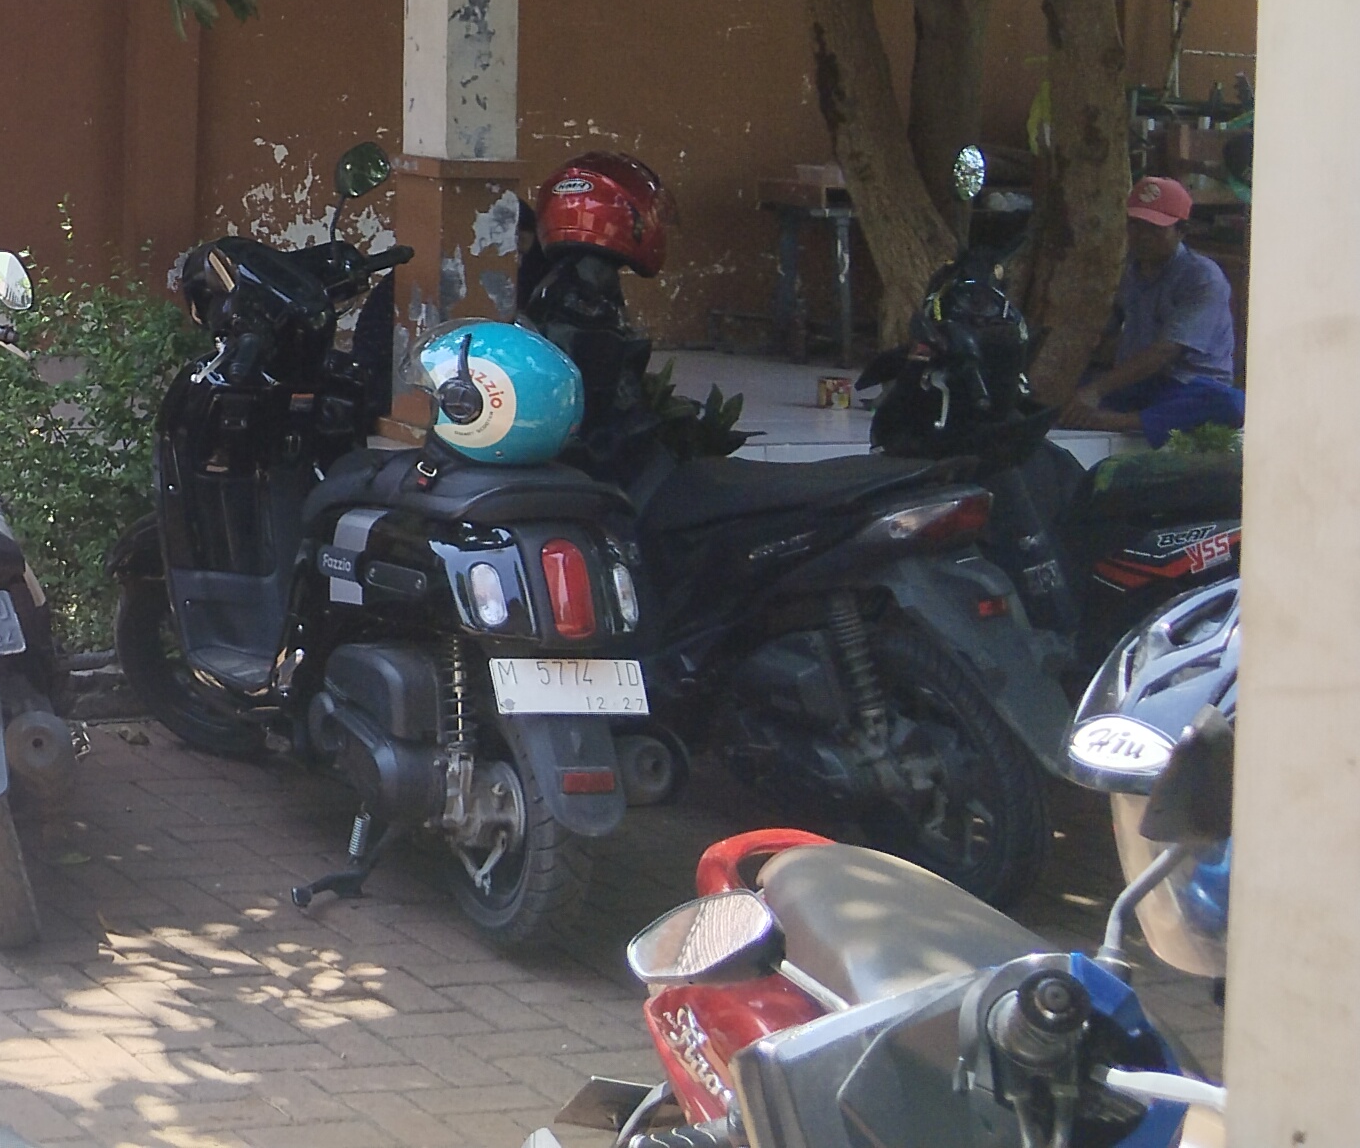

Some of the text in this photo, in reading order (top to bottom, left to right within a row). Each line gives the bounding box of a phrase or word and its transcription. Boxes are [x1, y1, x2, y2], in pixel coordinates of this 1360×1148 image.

[322, 553, 352, 572] Fazzio
[497, 660, 519, 686] M
[536, 660, 593, 686] 5774
